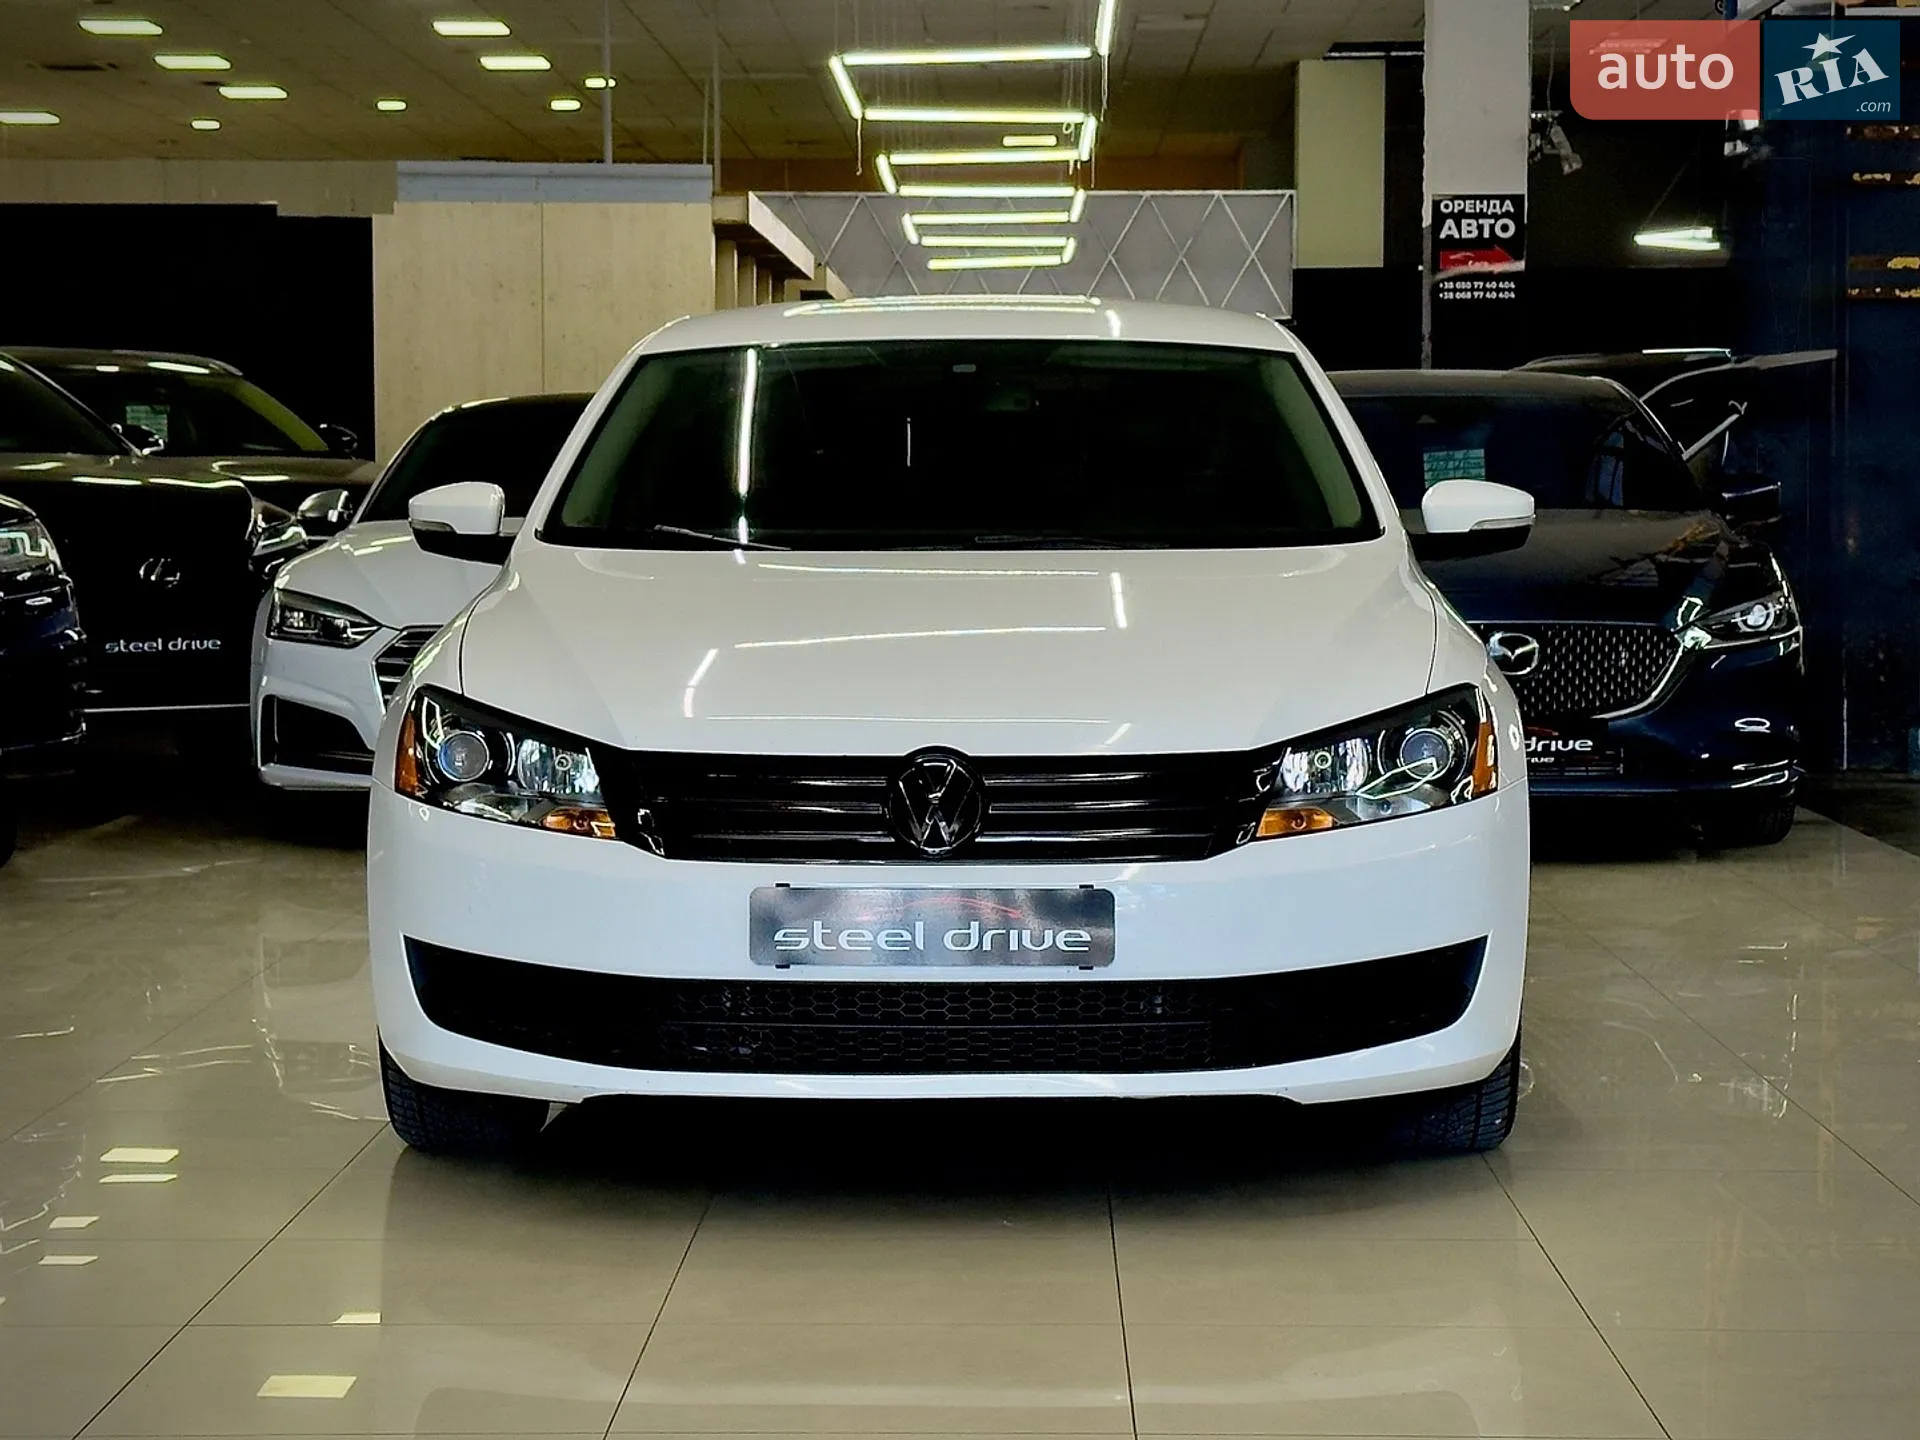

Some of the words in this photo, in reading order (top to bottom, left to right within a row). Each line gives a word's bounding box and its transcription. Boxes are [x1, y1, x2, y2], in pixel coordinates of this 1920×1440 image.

[1440, 199, 1515, 215] ОРЕНДА
[1439, 218, 1516, 239] АВТО
[1473, 281, 1484, 289] 77
[1473, 291, 1484, 299] 77
[105, 638, 163, 653] steel
[168, 637, 221, 651] drive
[773, 920, 925, 952] steel
[942, 920, 1093, 952] drive
